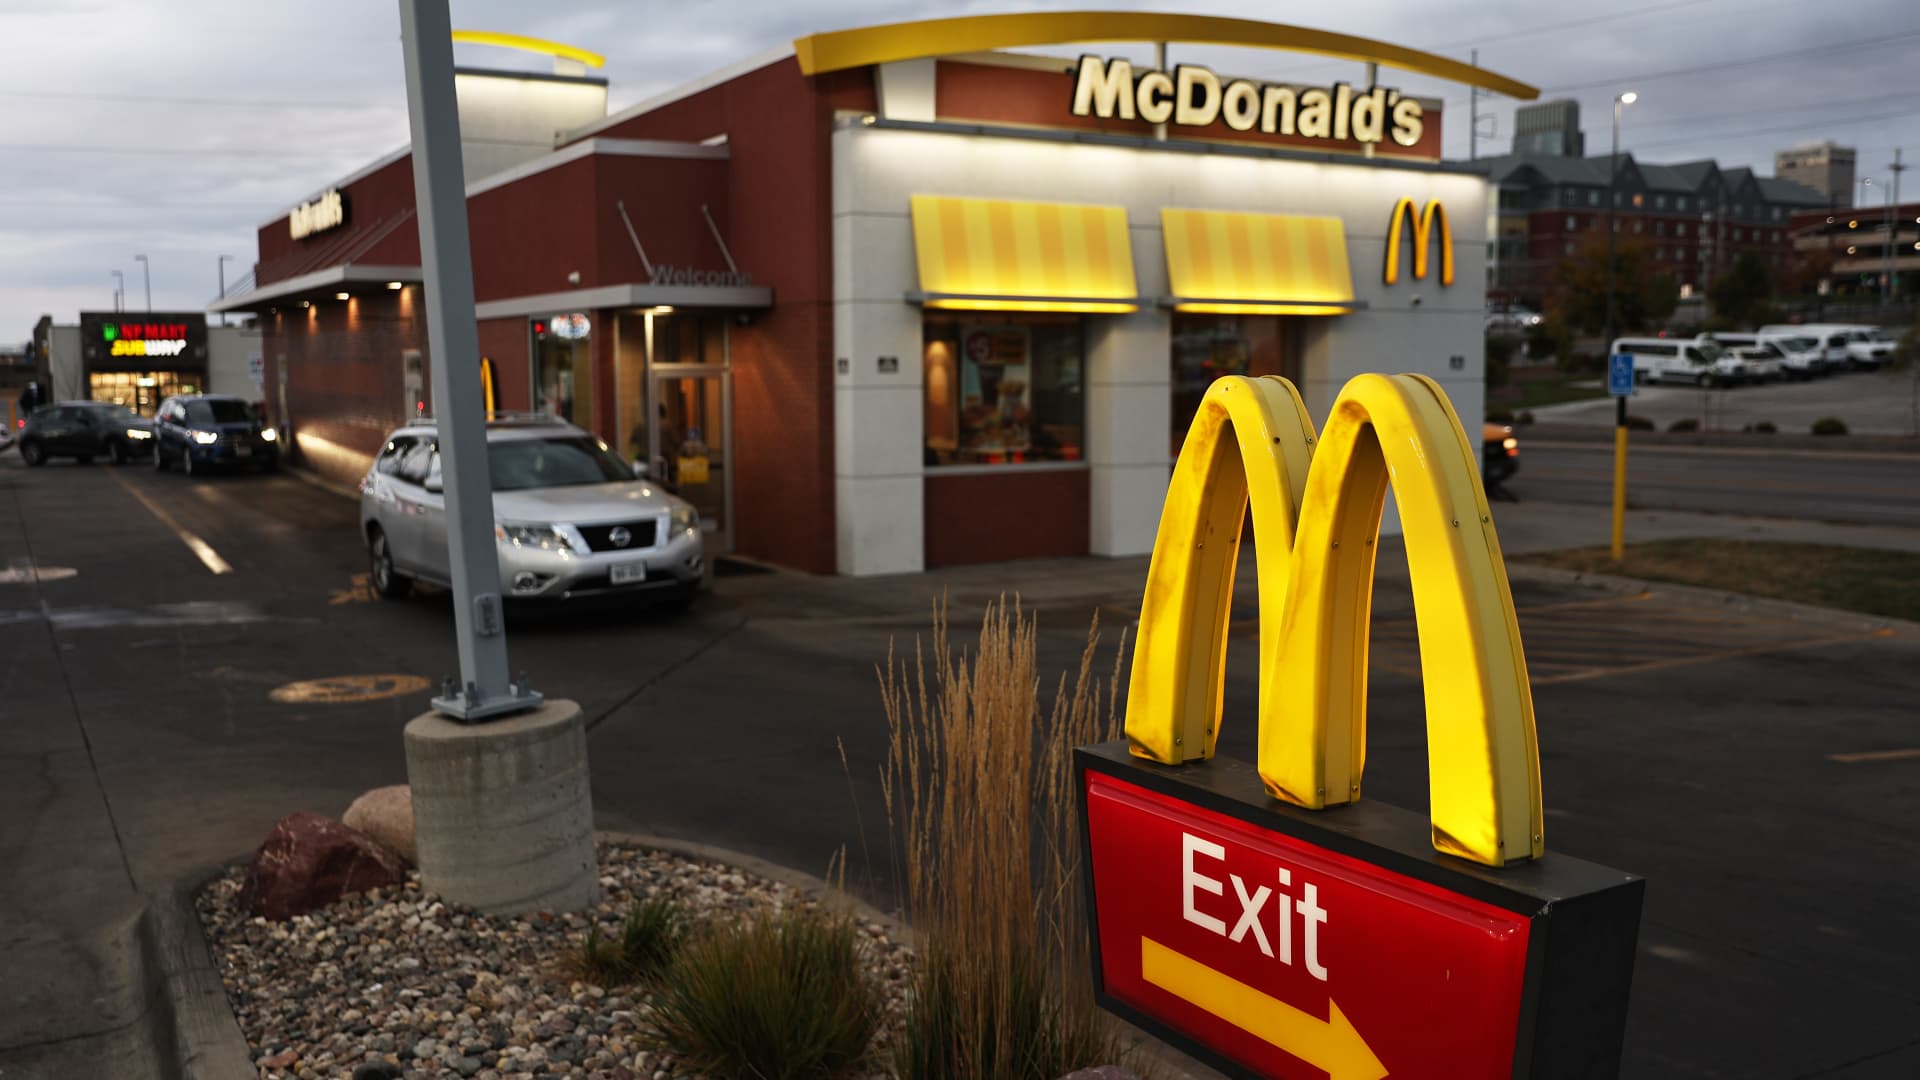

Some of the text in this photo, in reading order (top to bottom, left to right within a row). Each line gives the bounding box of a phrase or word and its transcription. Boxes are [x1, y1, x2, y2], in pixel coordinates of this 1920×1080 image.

[1073, 54, 1423, 146] McDonald's
[650, 263, 752, 288] Welcome
[144, 324, 187, 339] MART
[111, 339, 187, 356] SUBWAY
[1182, 831, 1328, 982] Exit
